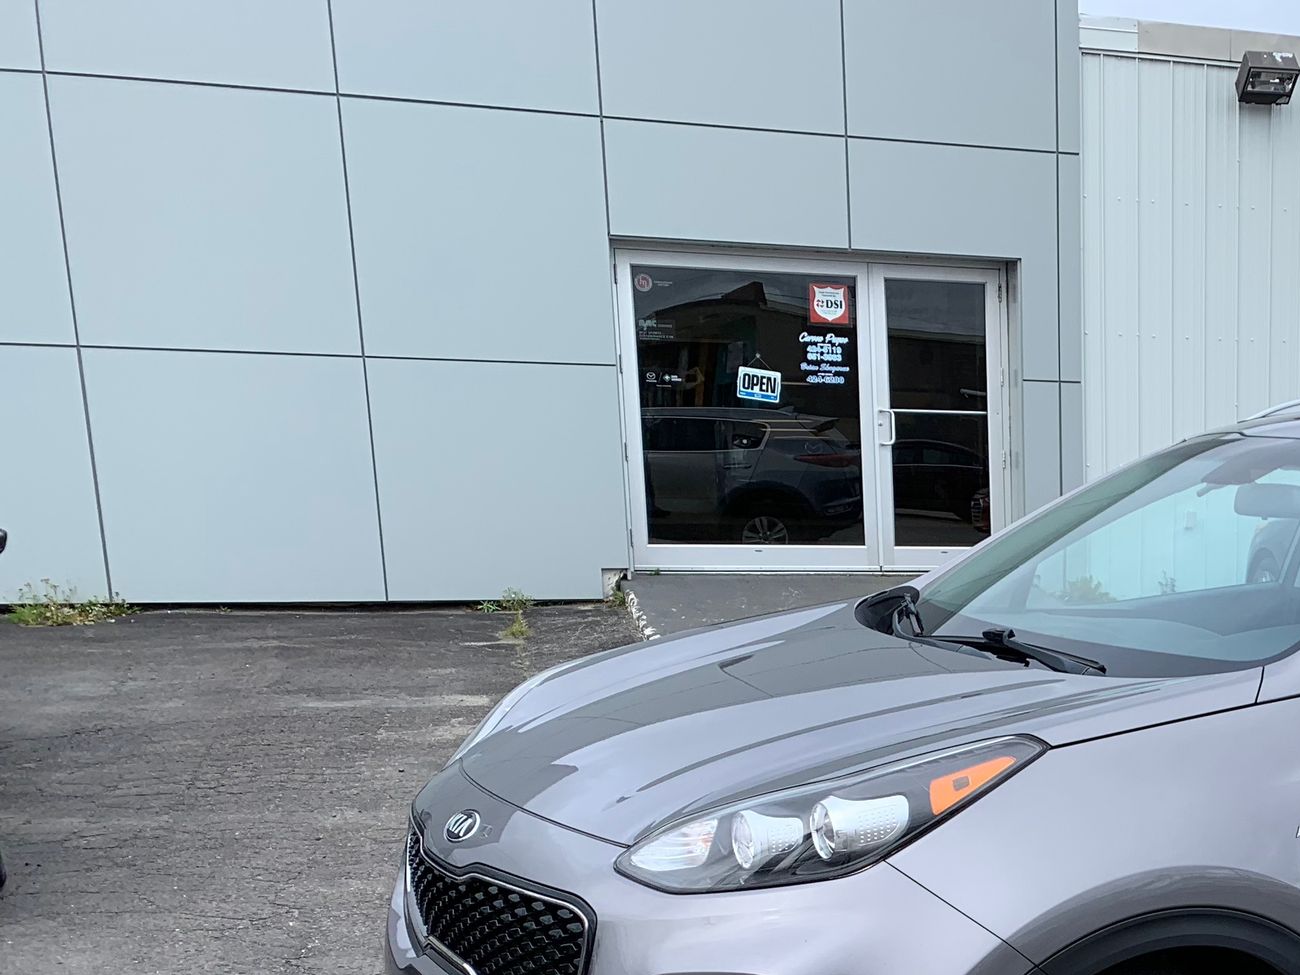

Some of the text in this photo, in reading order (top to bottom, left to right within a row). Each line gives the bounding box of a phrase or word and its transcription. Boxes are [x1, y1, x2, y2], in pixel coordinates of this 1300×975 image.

[826, 300, 843, 309] DSI
[742, 373, 777, 394] OPEN
[447, 812, 474, 837] KIA
